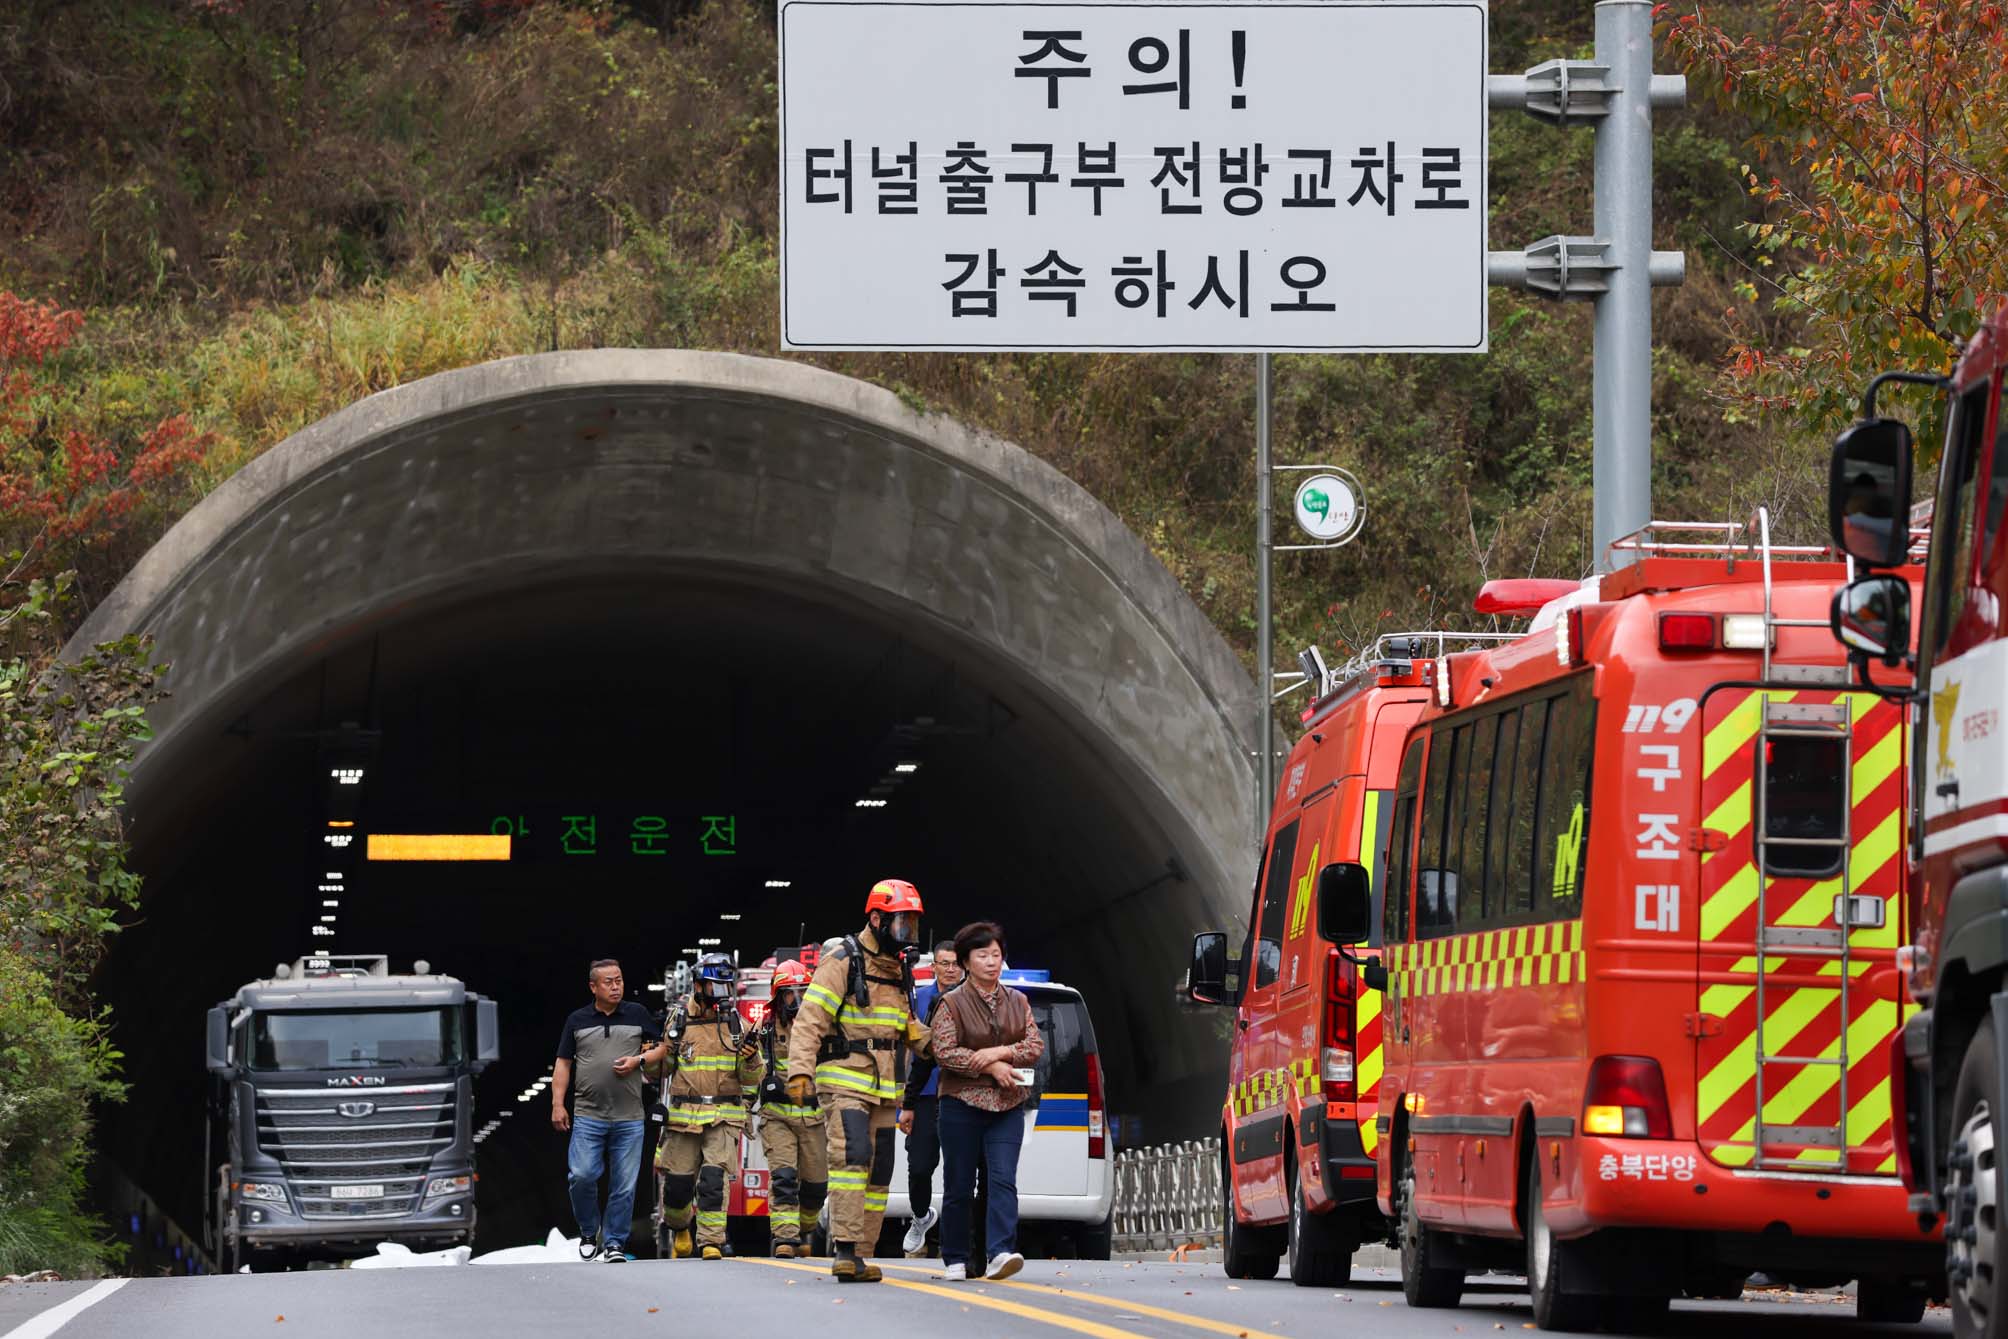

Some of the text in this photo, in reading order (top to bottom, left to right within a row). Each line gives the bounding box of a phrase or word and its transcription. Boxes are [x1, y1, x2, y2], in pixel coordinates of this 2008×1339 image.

[804, 139, 1470, 217] 터널출구부 전방교차로
[941, 249, 1336, 318] 감속하시오
[1621, 698, 1697, 733] 119
[328, 1076, 385, 1087] MAXEN
[1599, 1154, 1697, 1181] 충북단양
